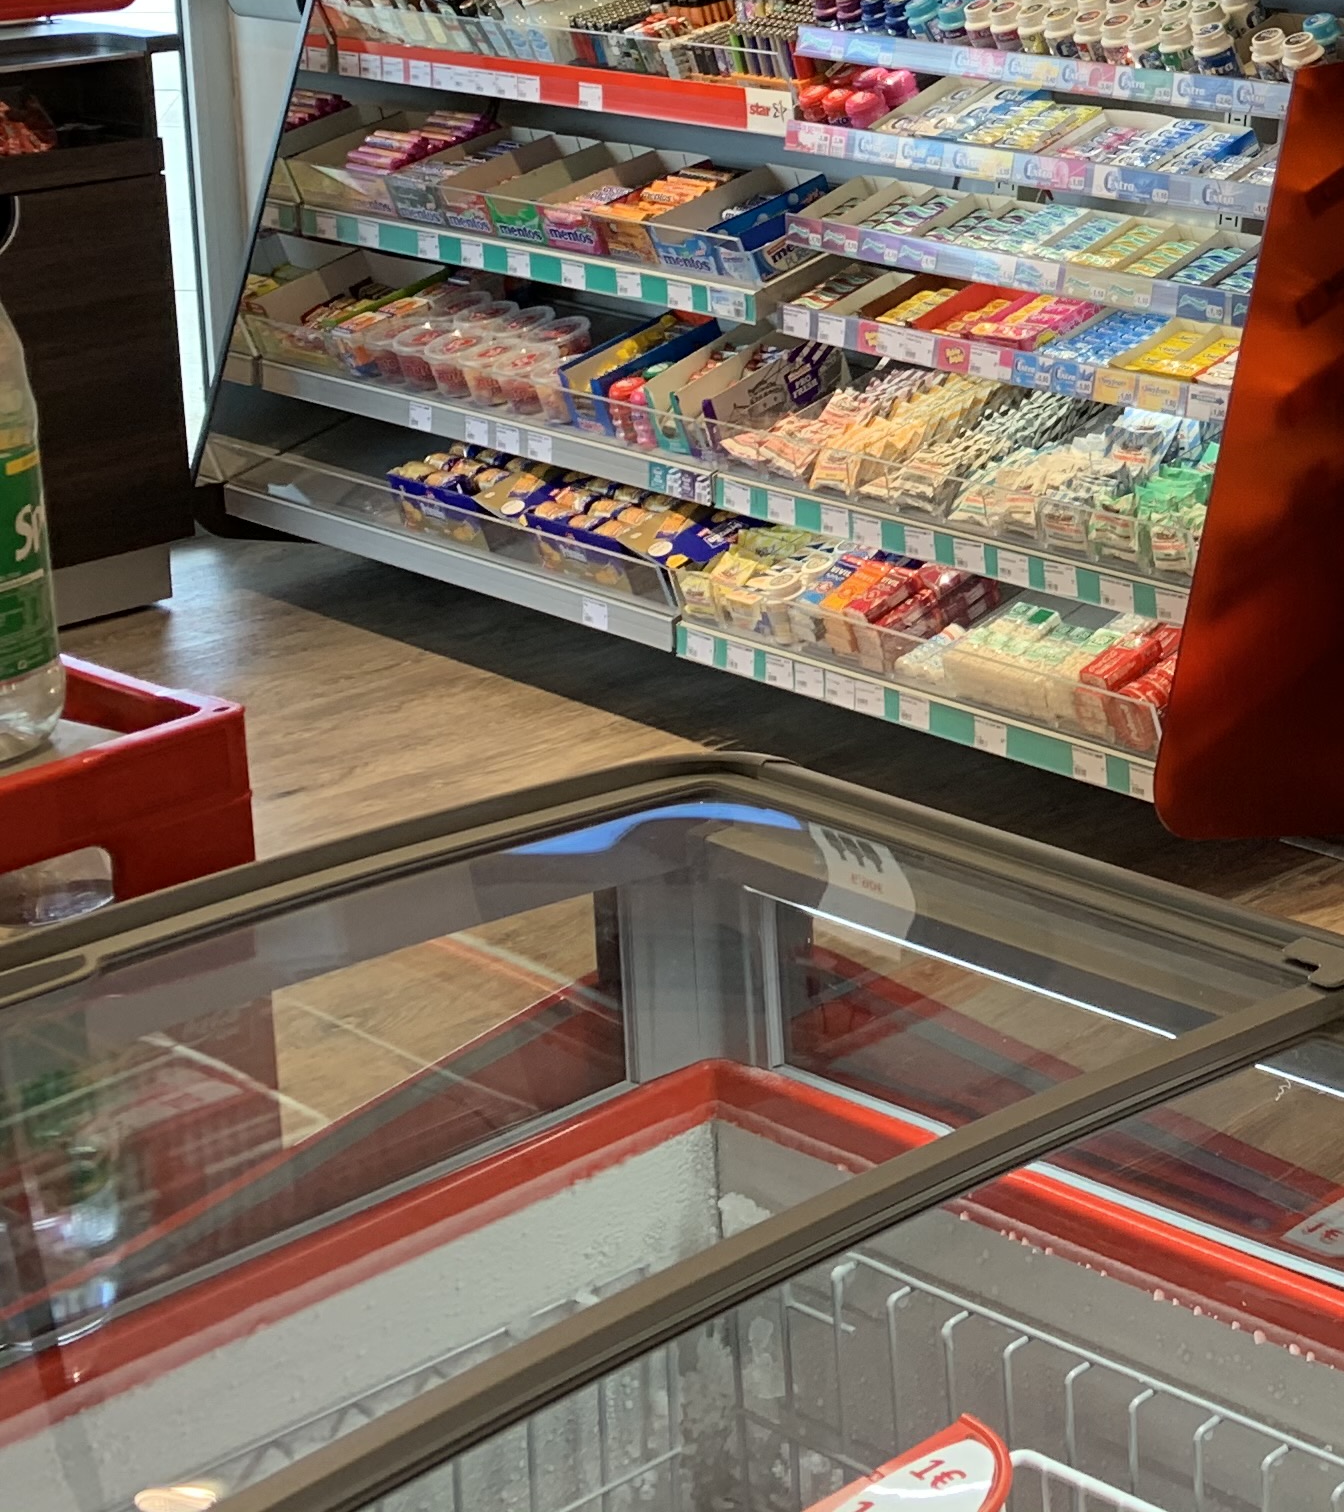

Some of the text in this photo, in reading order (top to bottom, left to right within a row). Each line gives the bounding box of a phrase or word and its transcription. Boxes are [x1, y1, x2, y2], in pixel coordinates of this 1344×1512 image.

[749, 101, 770, 118] star
[498, 224, 543, 242] mentos
[549, 228, 594, 245] mentos
